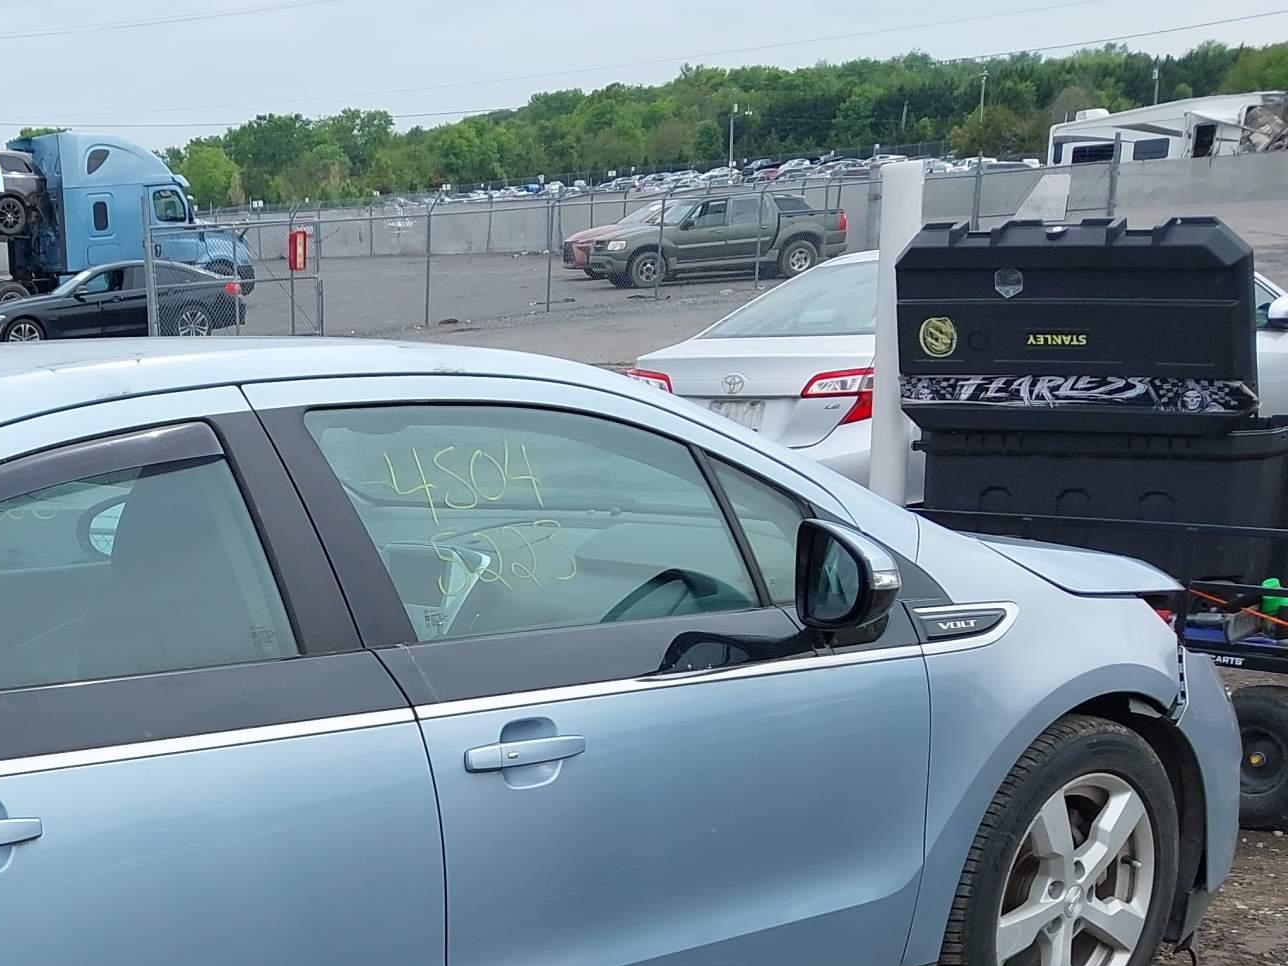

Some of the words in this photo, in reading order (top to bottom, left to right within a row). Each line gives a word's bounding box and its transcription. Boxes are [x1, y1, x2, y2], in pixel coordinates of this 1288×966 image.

[1027, 334, 1087, 345] STANLEY
[957, 375, 1151, 408] FEARLESS
[382, 437, 544, 526] 4504
[430, 519, 576, 596] 5223
[938, 619, 977, 630] VOLT
